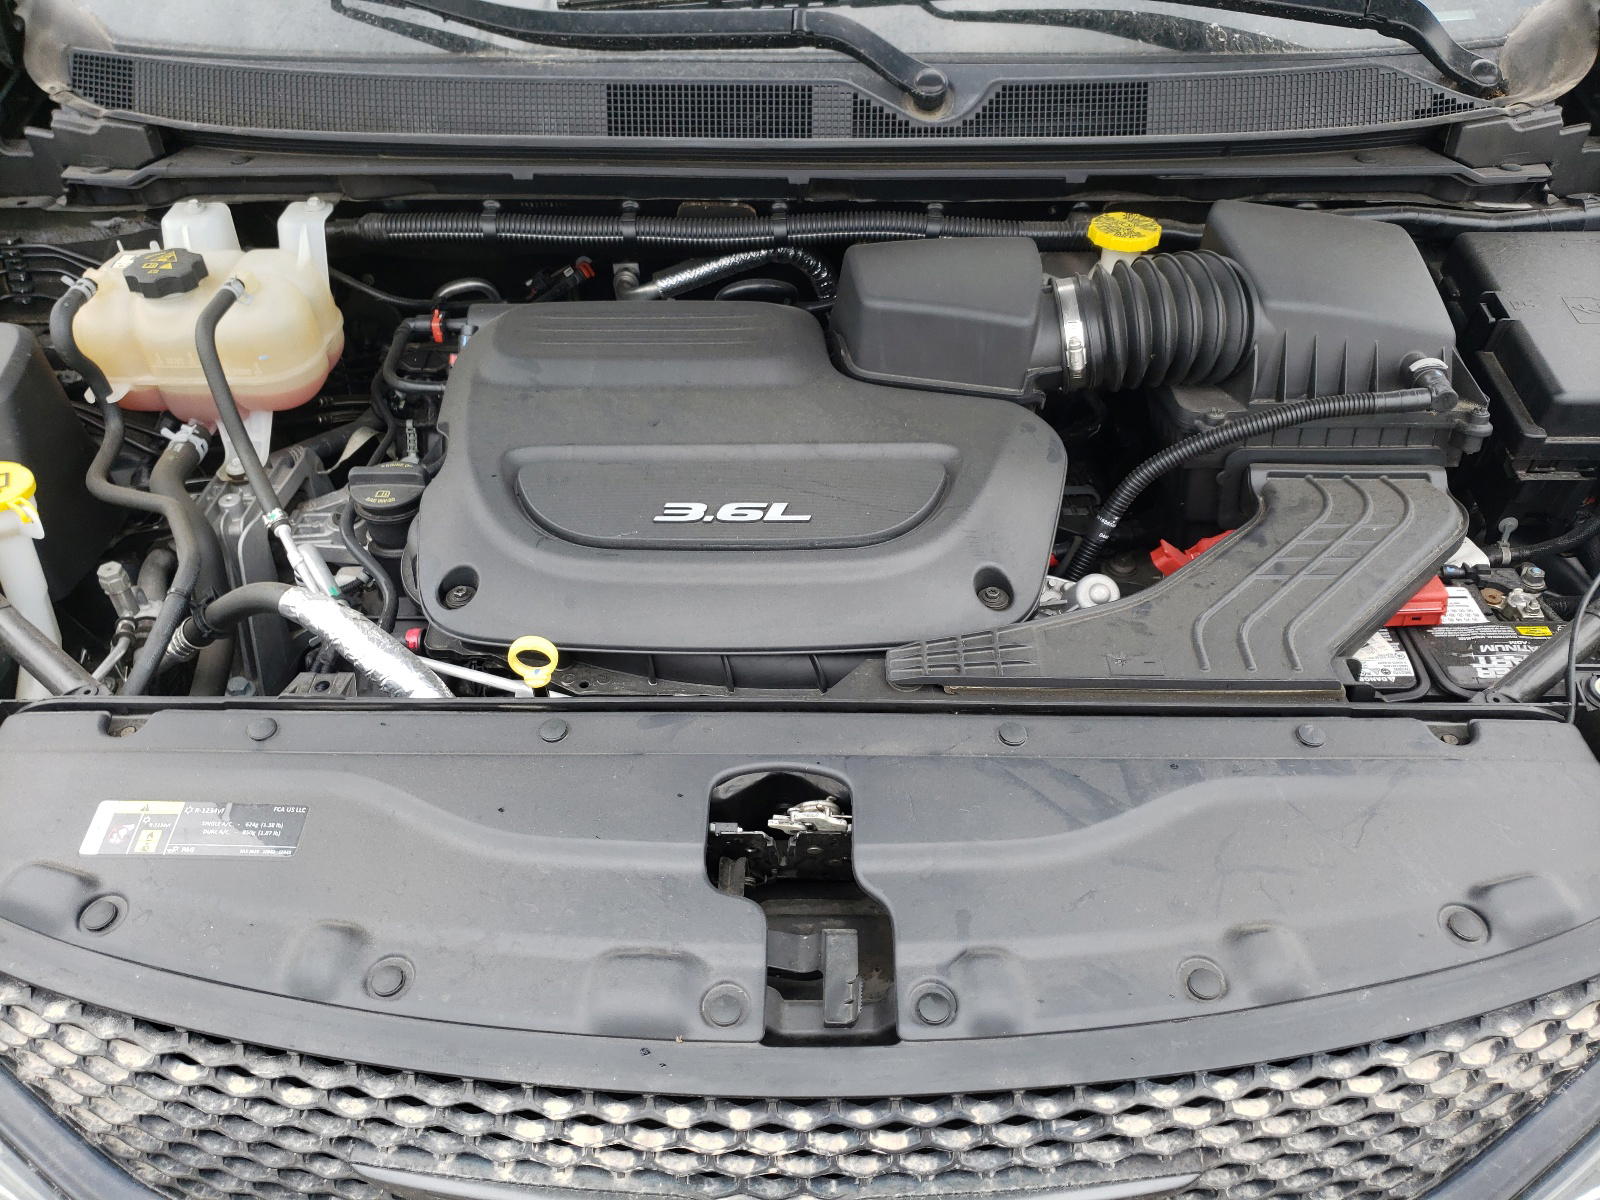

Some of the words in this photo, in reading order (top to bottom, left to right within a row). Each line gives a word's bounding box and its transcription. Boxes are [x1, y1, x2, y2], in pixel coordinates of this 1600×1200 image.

[653, 502, 812, 523] 3.6L
[1480, 644, 1541, 653] ATINUM
[1470, 656, 1533, 668] ART
